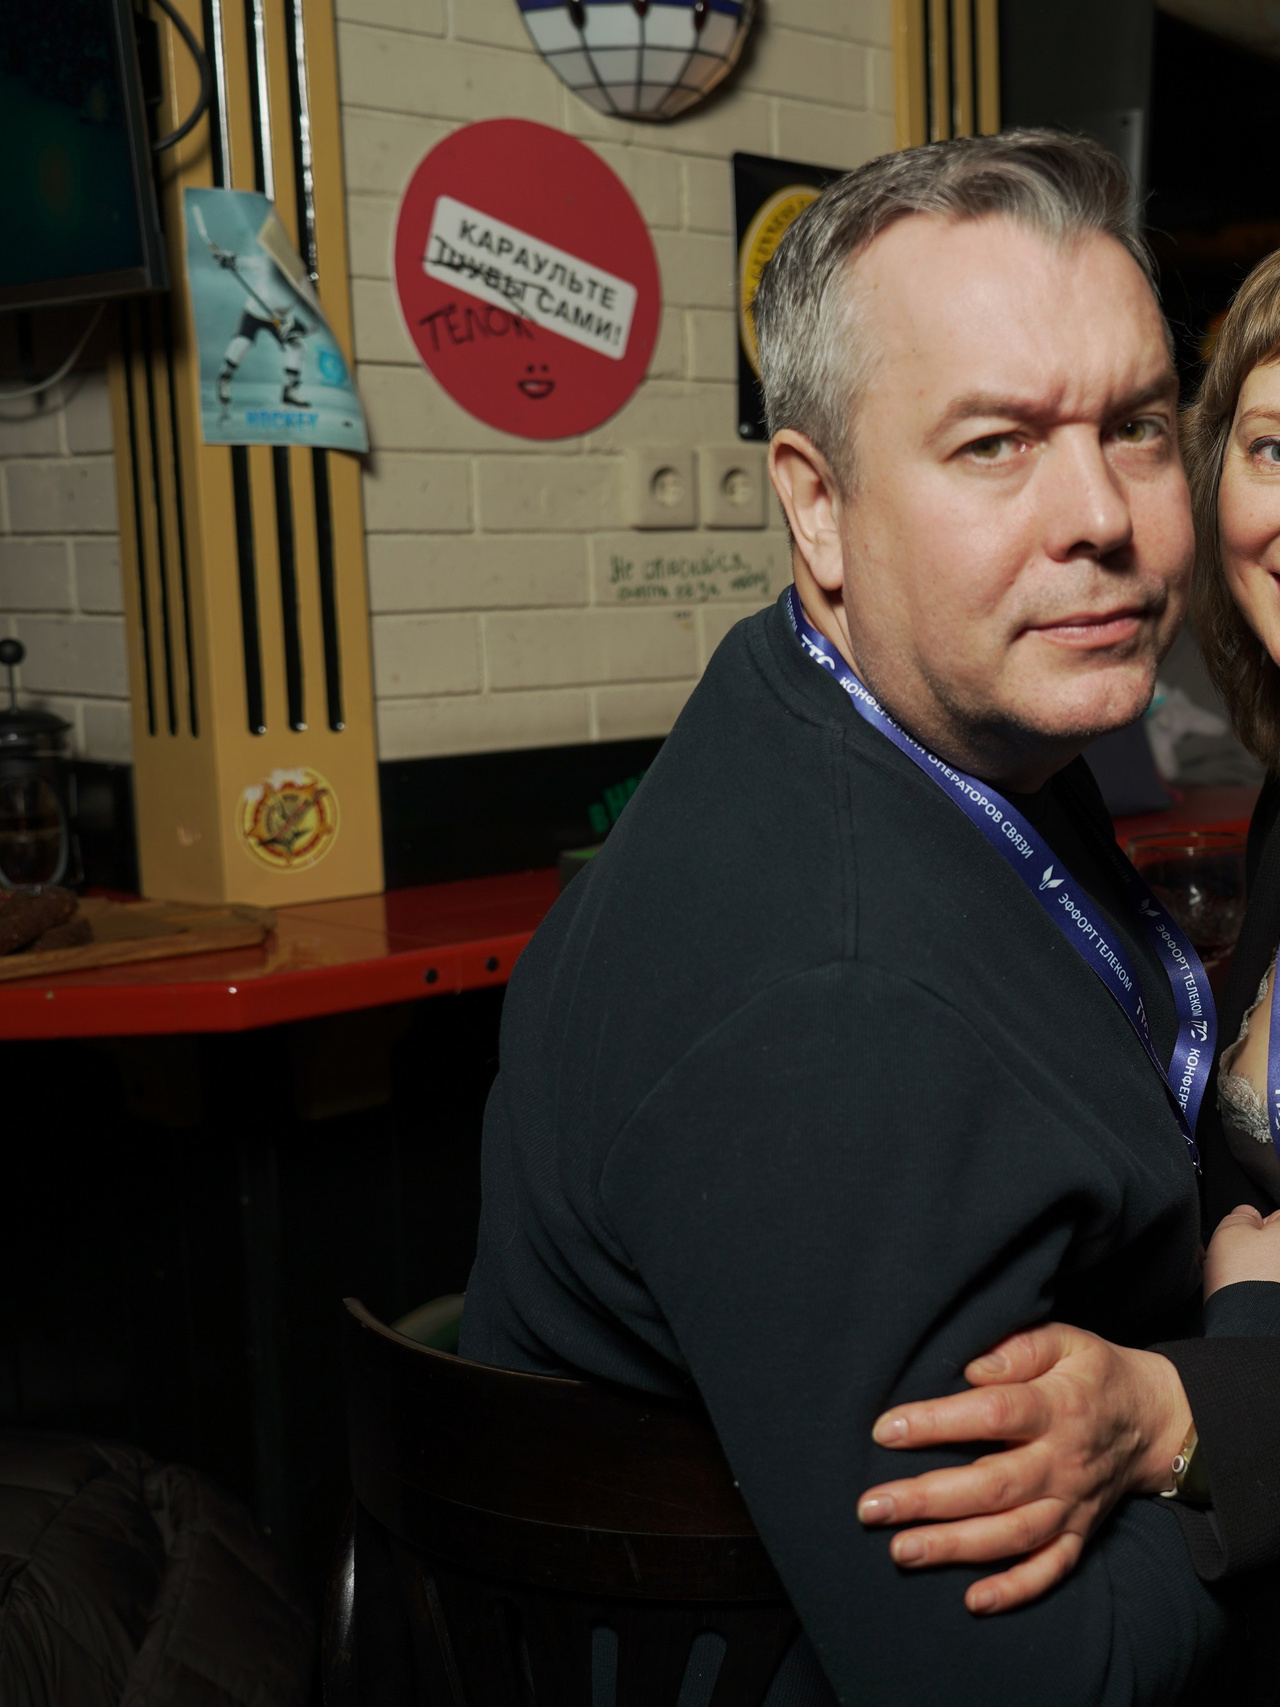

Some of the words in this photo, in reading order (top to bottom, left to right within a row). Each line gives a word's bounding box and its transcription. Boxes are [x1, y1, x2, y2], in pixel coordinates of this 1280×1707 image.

[458, 219, 618, 310] КАРАУЛЬТЕ
[535, 286, 622, 345] САМИ!
[245, 411, 319, 430] HOCKEY
[927, 753, 1004, 824] ОПЕРАТОРОВ
[1001, 820, 1034, 859] СВЯЗИ
[1057, 892, 1098, 941] ЭФФОРТ
[1095, 937, 1134, 992] ТЕЛЕКОМ
[1155, 923, 1191, 972] ЭФФОРТ
[1181, 971, 1203, 1017] ТЕЛЕКОМ
[1178, 1047, 1201, 1114] КОНФЕРЕ
